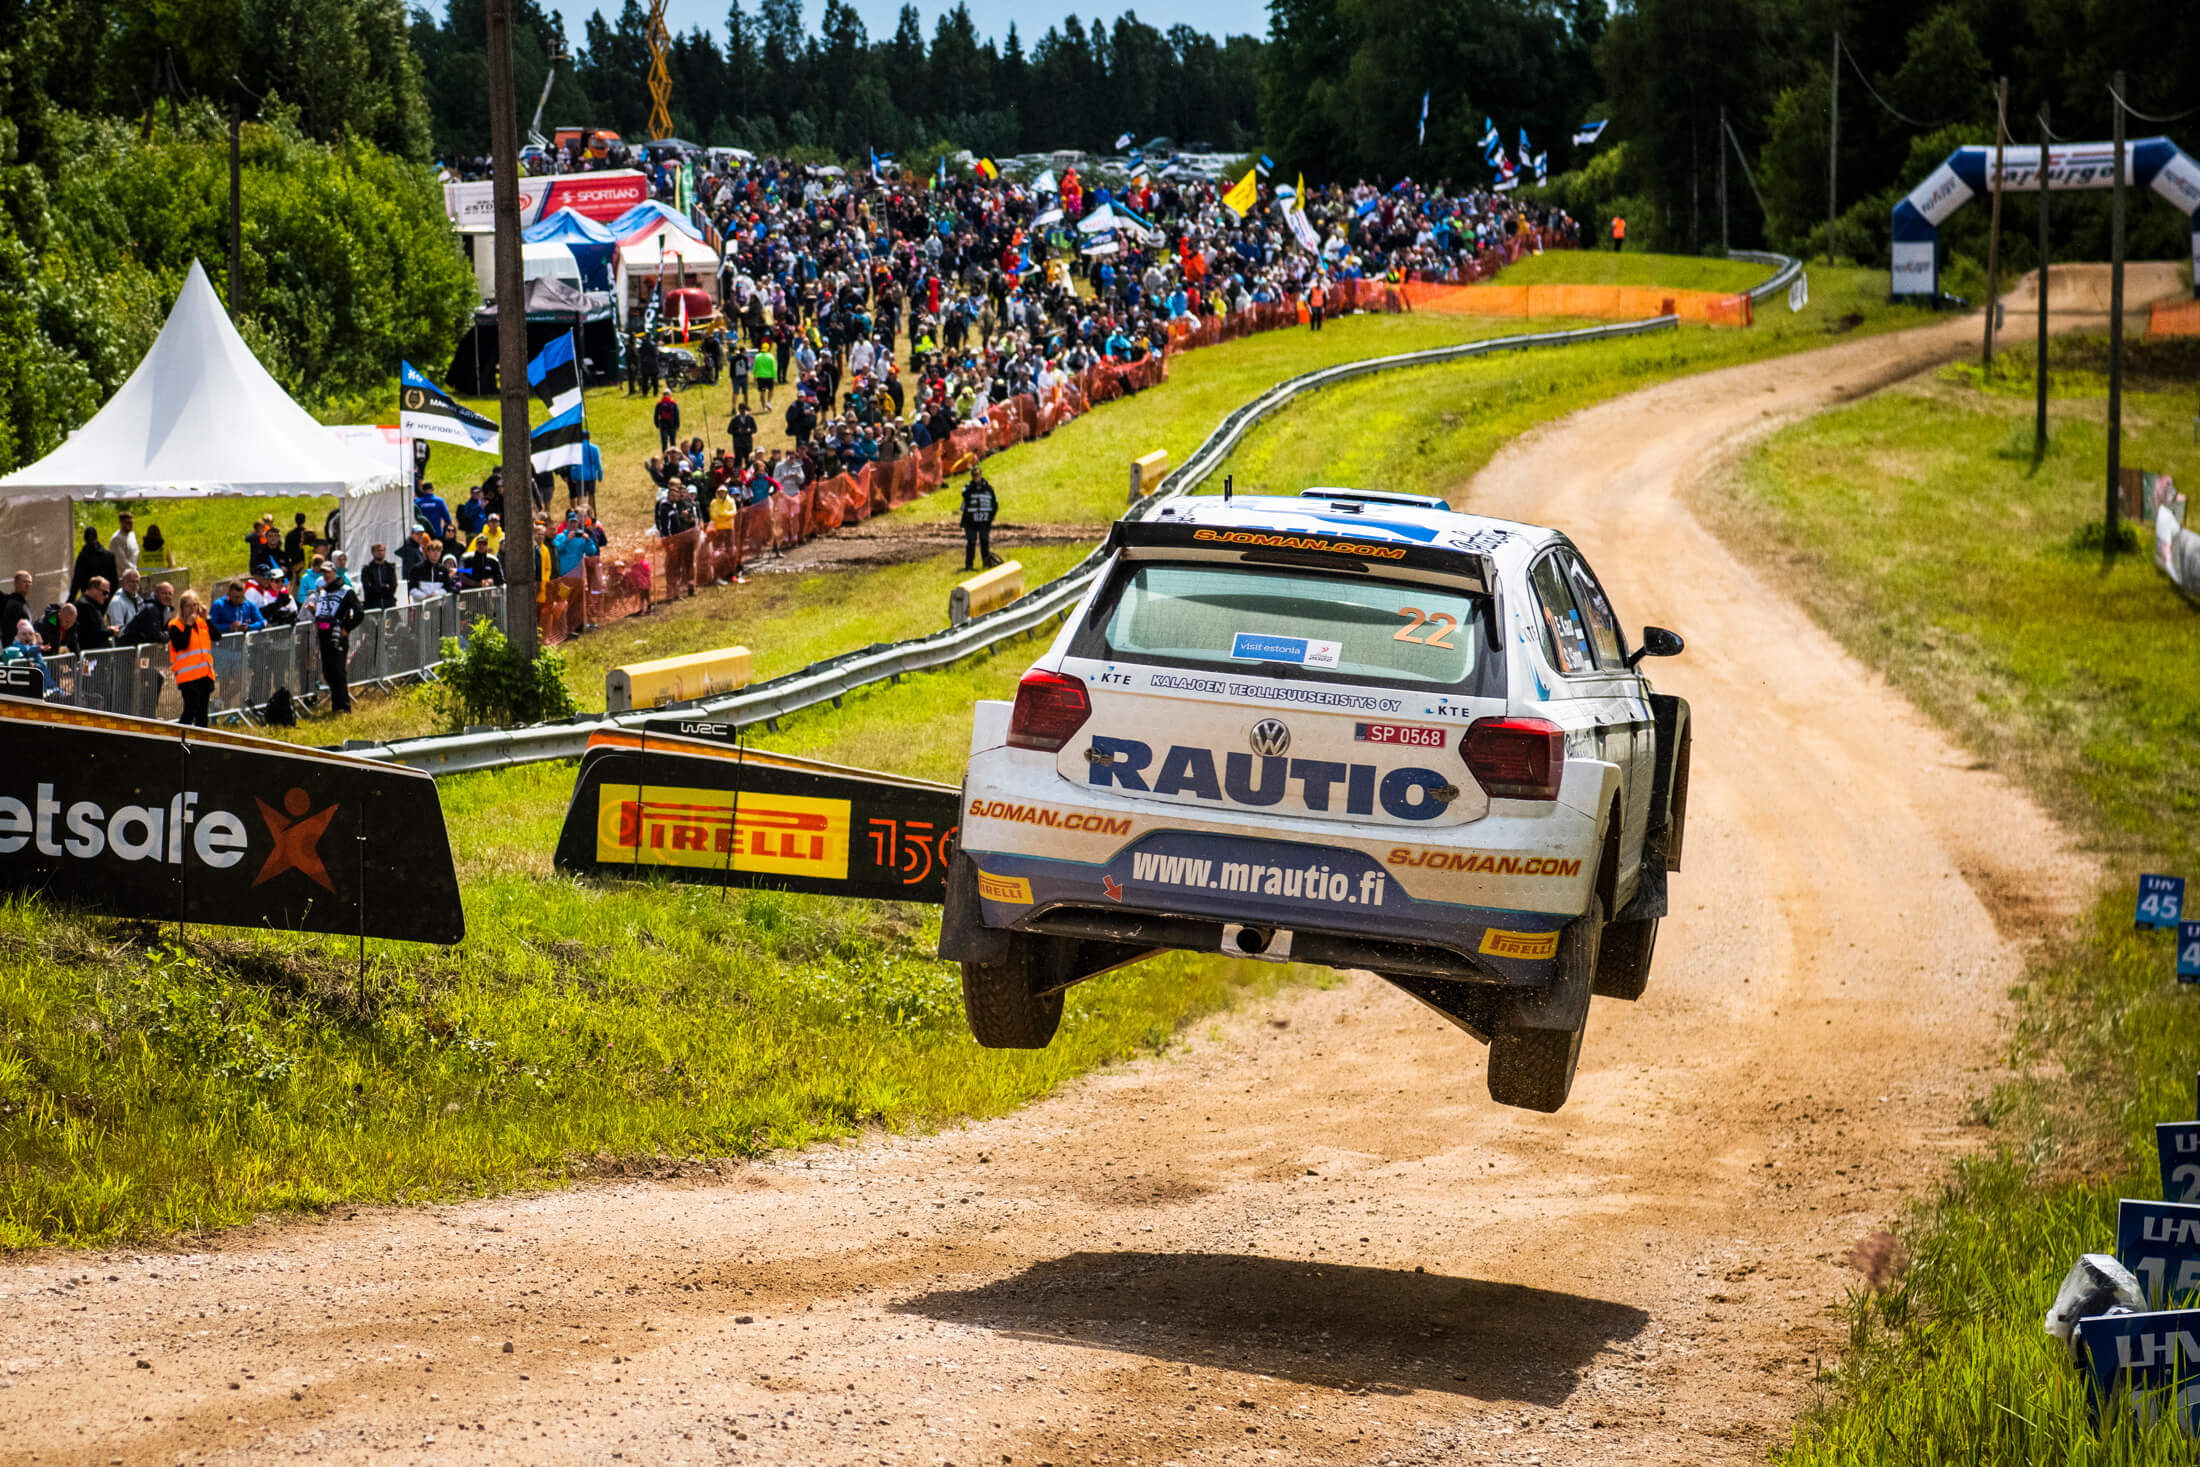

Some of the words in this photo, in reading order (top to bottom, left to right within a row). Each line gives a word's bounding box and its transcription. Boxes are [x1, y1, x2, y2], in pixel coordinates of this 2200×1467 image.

[577, 188, 639, 202] SPORTLAND
[1193, 528, 1407, 559] SJOMAN.COM
[1393, 607, 1457, 650] 22
[1240, 638, 1262, 651] visit
[1263, 642, 1302, 655] estonia
[1100, 672, 1132, 686] KTE
[1150, 674, 1226, 694] KALAJOEN
[1229, 683, 1377, 710] TEOLLISUUSERISTYS
[1379, 698, 1402, 713] OY
[1437, 705, 1470, 718] KTE
[680, 721, 728, 735] WRC
[1370, 725, 1395, 742] SP
[1399, 728, 1442, 746] 0568
[1089, 735, 1450, 821] RAUTIO
[0, 782, 248, 868] etsafe
[619, 800, 829, 861] PIRELLI
[968, 799, 1133, 836] SJOMAN.COM
[1386, 847, 1582, 878] SJOMAN.COM
[1133, 851, 1386, 906] www.mrautio.fi
[2141, 893, 2178, 919] 45
[1489, 933, 1554, 955] PIRELLI
[2182, 941, 2200, 969] 4
[2171, 1163, 2200, 1201] 2
